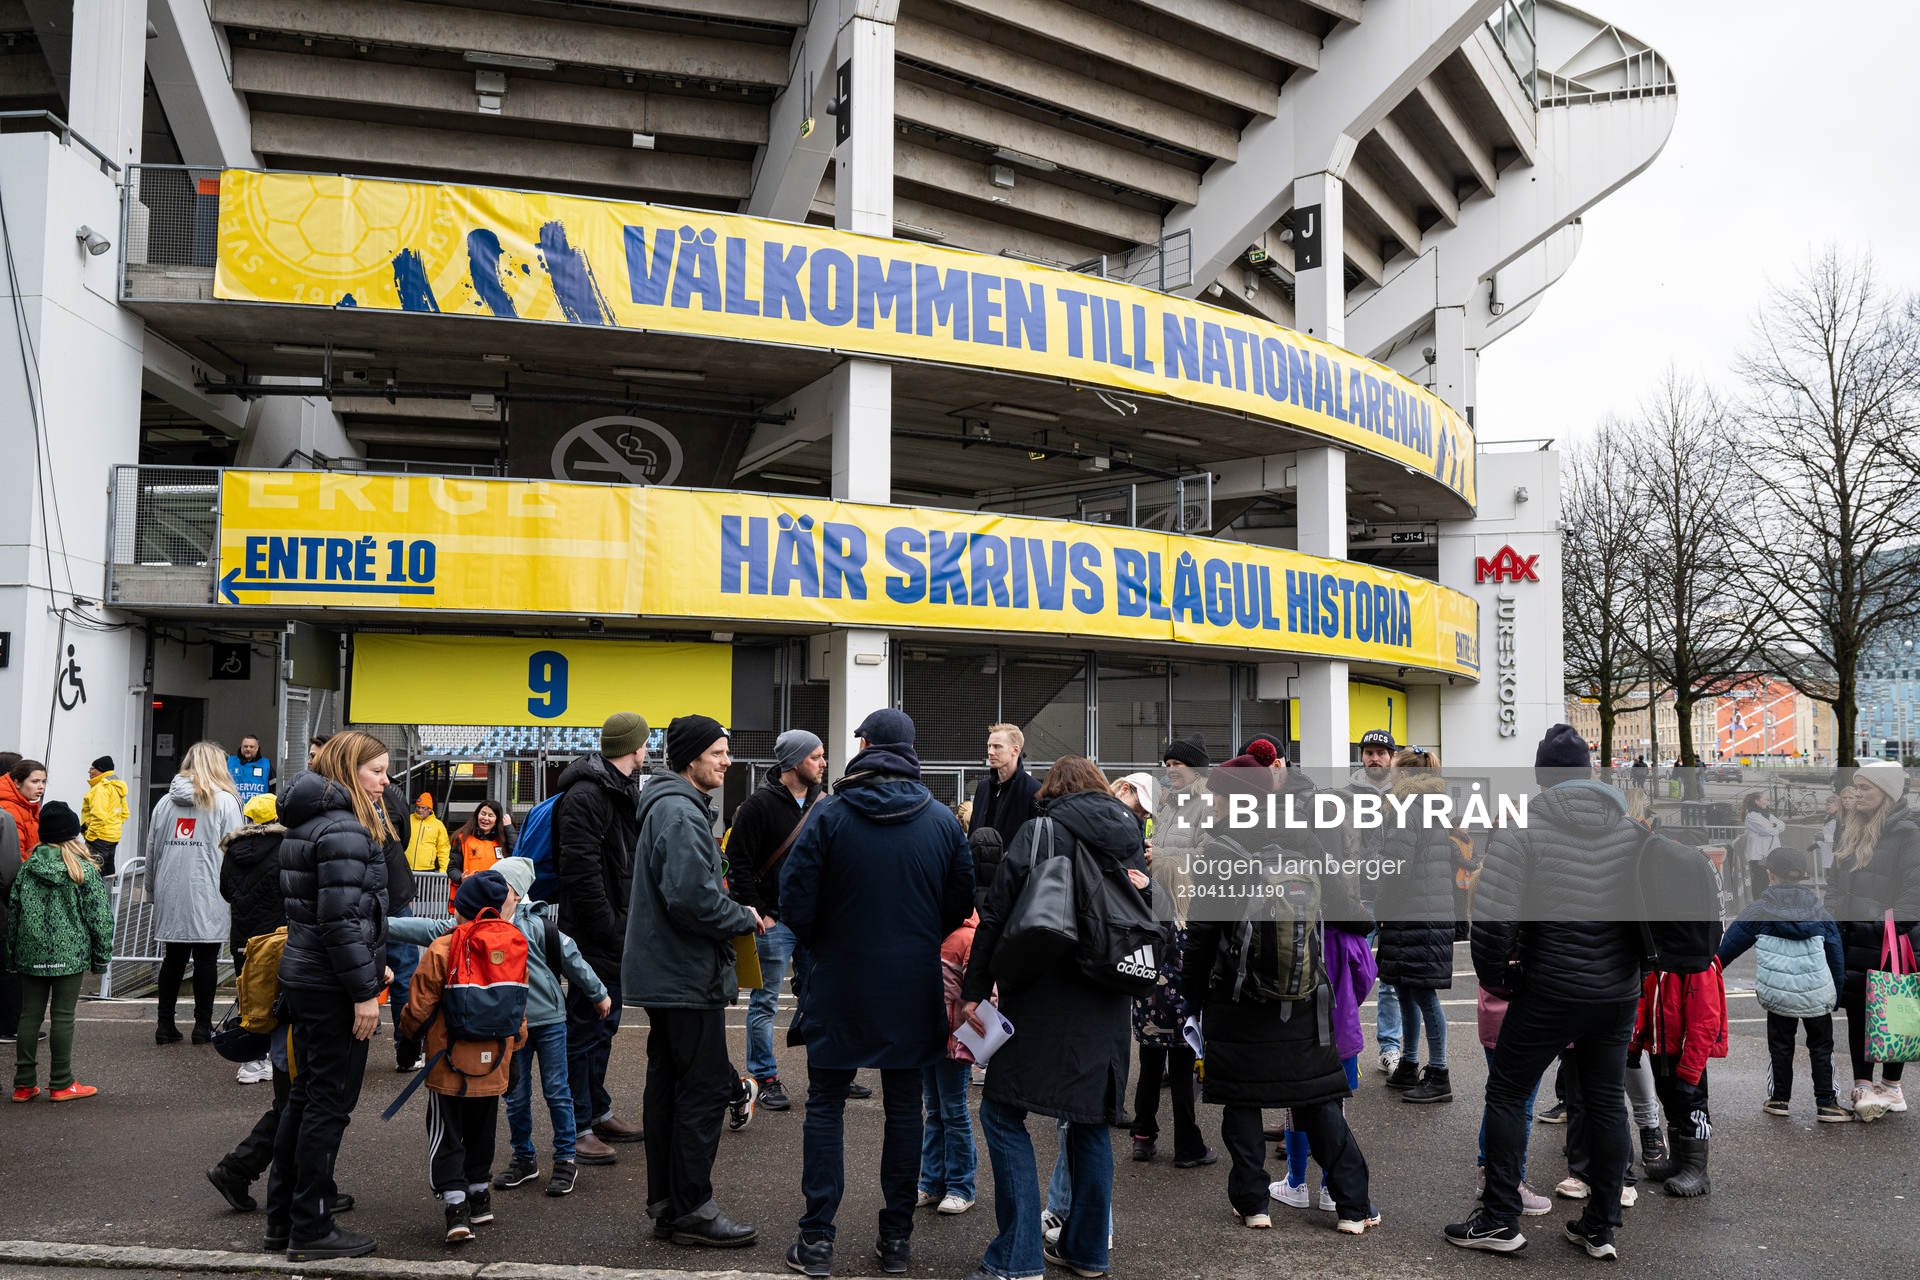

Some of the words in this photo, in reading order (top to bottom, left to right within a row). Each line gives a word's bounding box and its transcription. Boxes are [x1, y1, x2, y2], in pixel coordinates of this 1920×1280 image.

[840, 75, 848, 105] L
[1301, 213, 1314, 238] J
[1305, 255, 1310, 263] 1
[623, 224, 1048, 353] VÄLKOMMEN
[1057, 287, 1155, 374] TILL
[1163, 311, 1433, 459] NATIONALARENAN
[1404, 533, 1423, 541] J1-4
[245, 535, 377, 582] ENTRÉ
[386, 539, 436, 584] 10
[1475, 543, 1540, 584] MAX
[721, 512, 868, 601] HÄR
[885, 526, 1104, 615] SKRIVS
[1114, 547, 1280, 630] BLÅGUL
[1286, 568, 1412, 648] HISTORIA
[1498, 593, 1517, 738] JURESKOGS
[528, 650, 569, 719] 9
[235, 783, 265, 792] SERVICE
[1116, 961, 1158, 980] adidas
